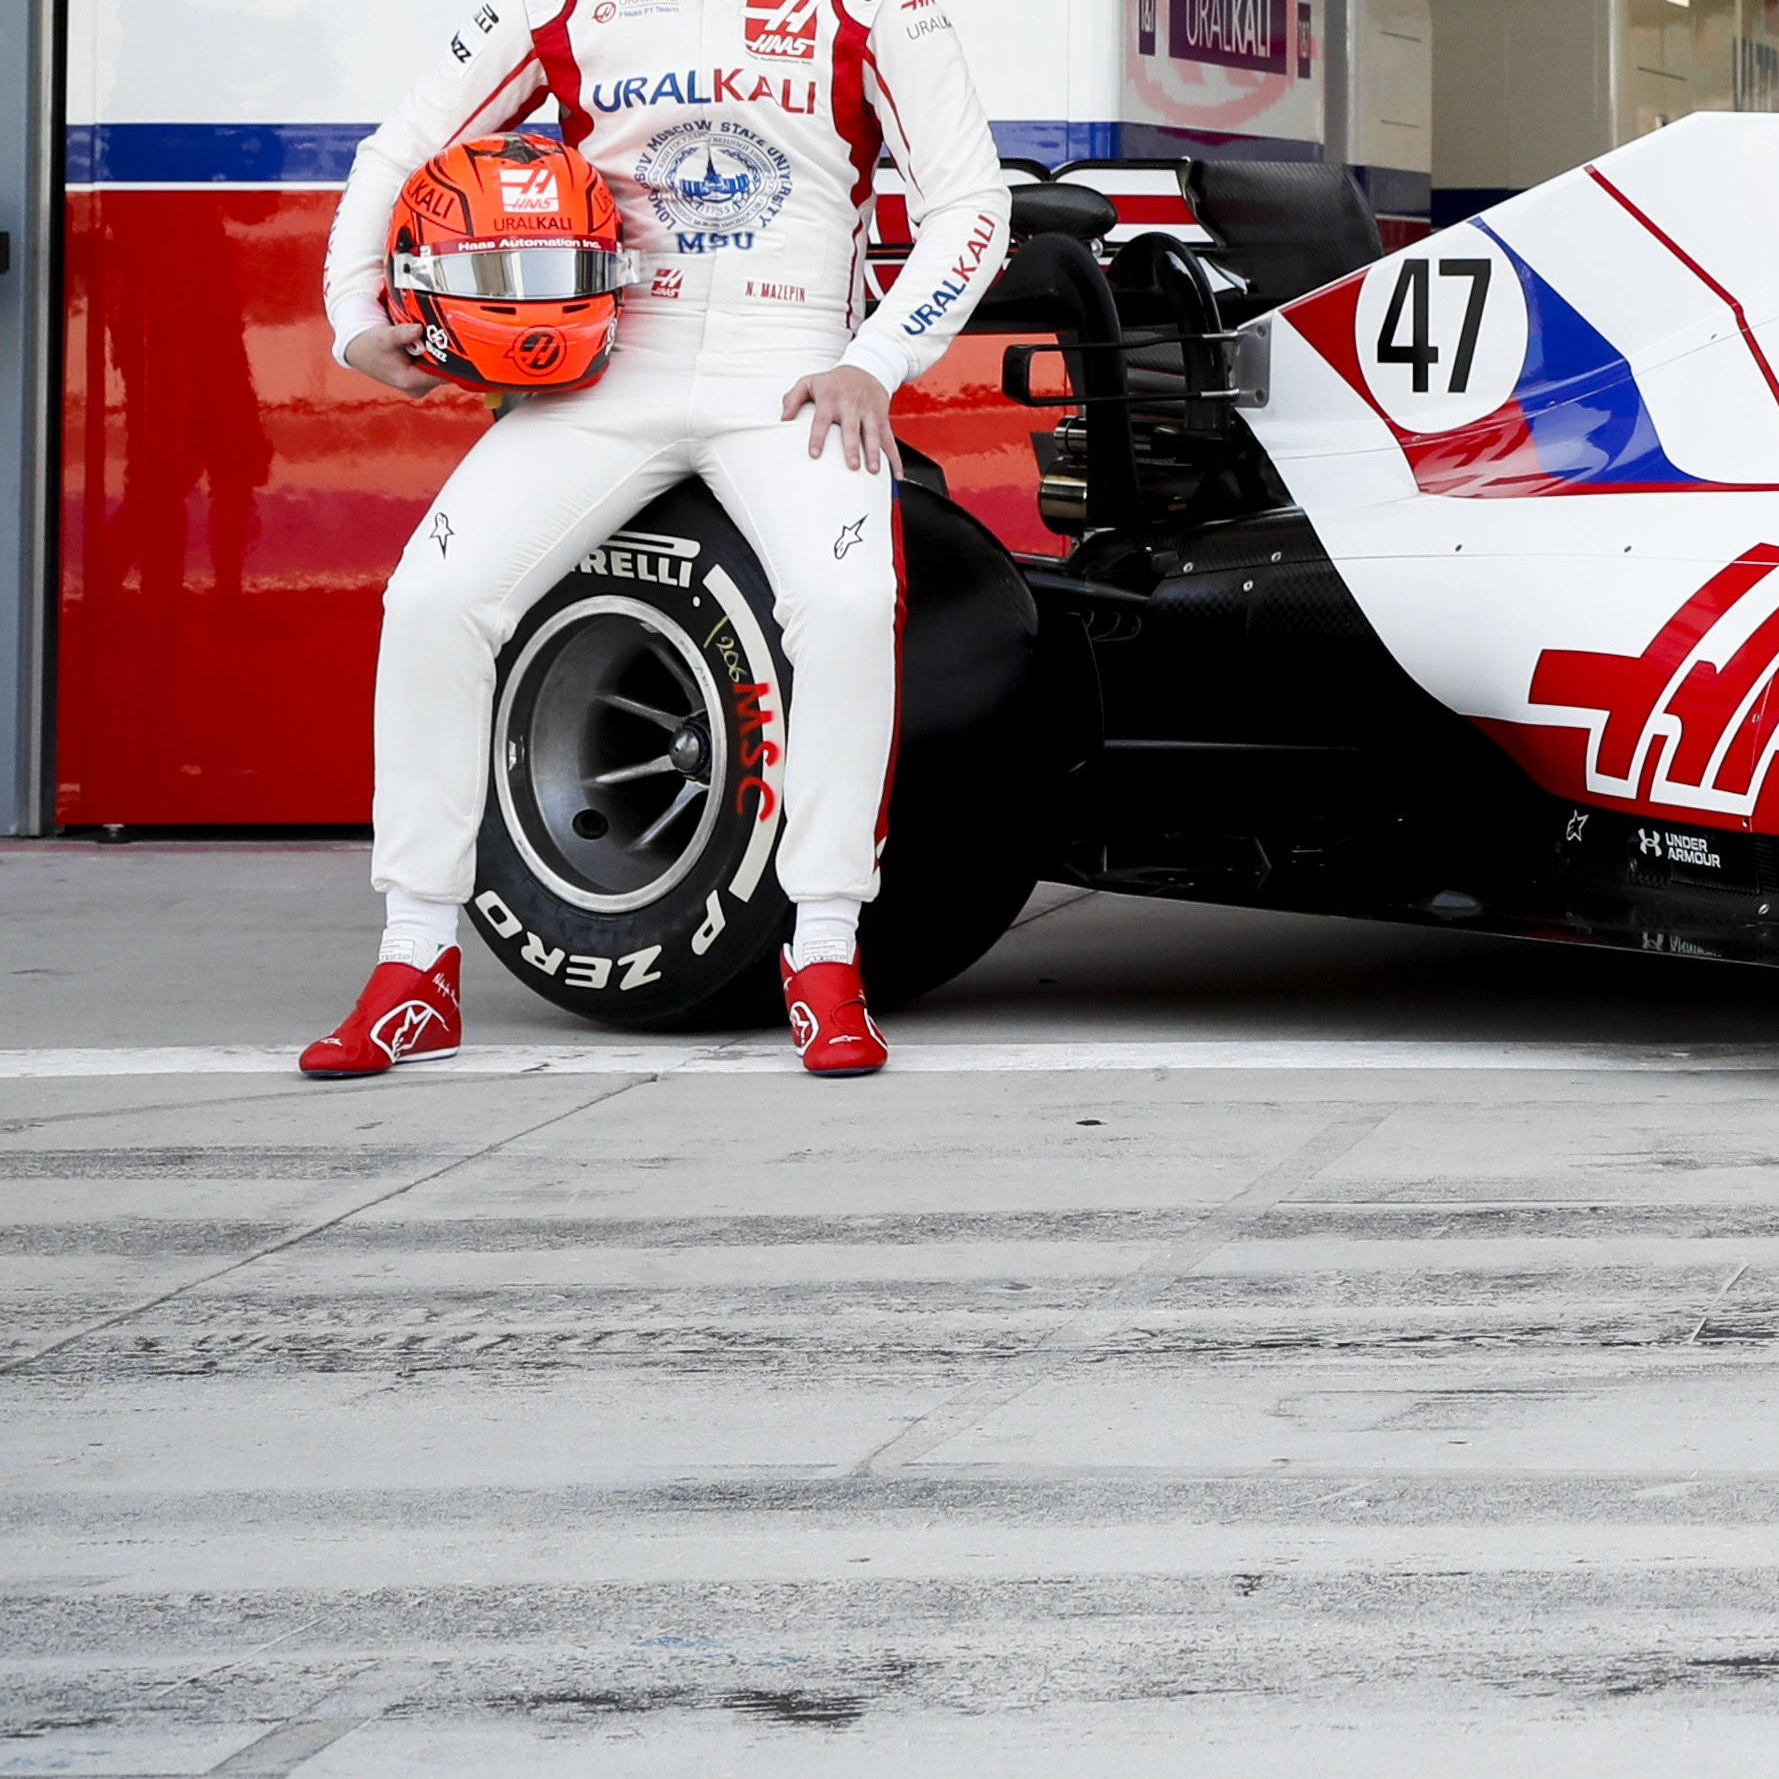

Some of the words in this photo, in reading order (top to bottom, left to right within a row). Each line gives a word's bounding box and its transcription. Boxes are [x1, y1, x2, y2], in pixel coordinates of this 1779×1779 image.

[592, 68, 817, 115] URALKALI
[493, 216, 573, 233] URALKALI
[458, 241, 496, 252] Haas
[499, 237, 580, 250] Automation
[675, 231, 755, 253] MSU
[902, 214, 996, 336] URALKALI
[761, 282, 806, 302] MAZEPIN
[1376, 258, 1492, 393] 47
[1664, 831, 1708, 853] UNDER
[1667, 846, 1722, 868] ARMOUR
[474, 889, 662, 991] ZERO
